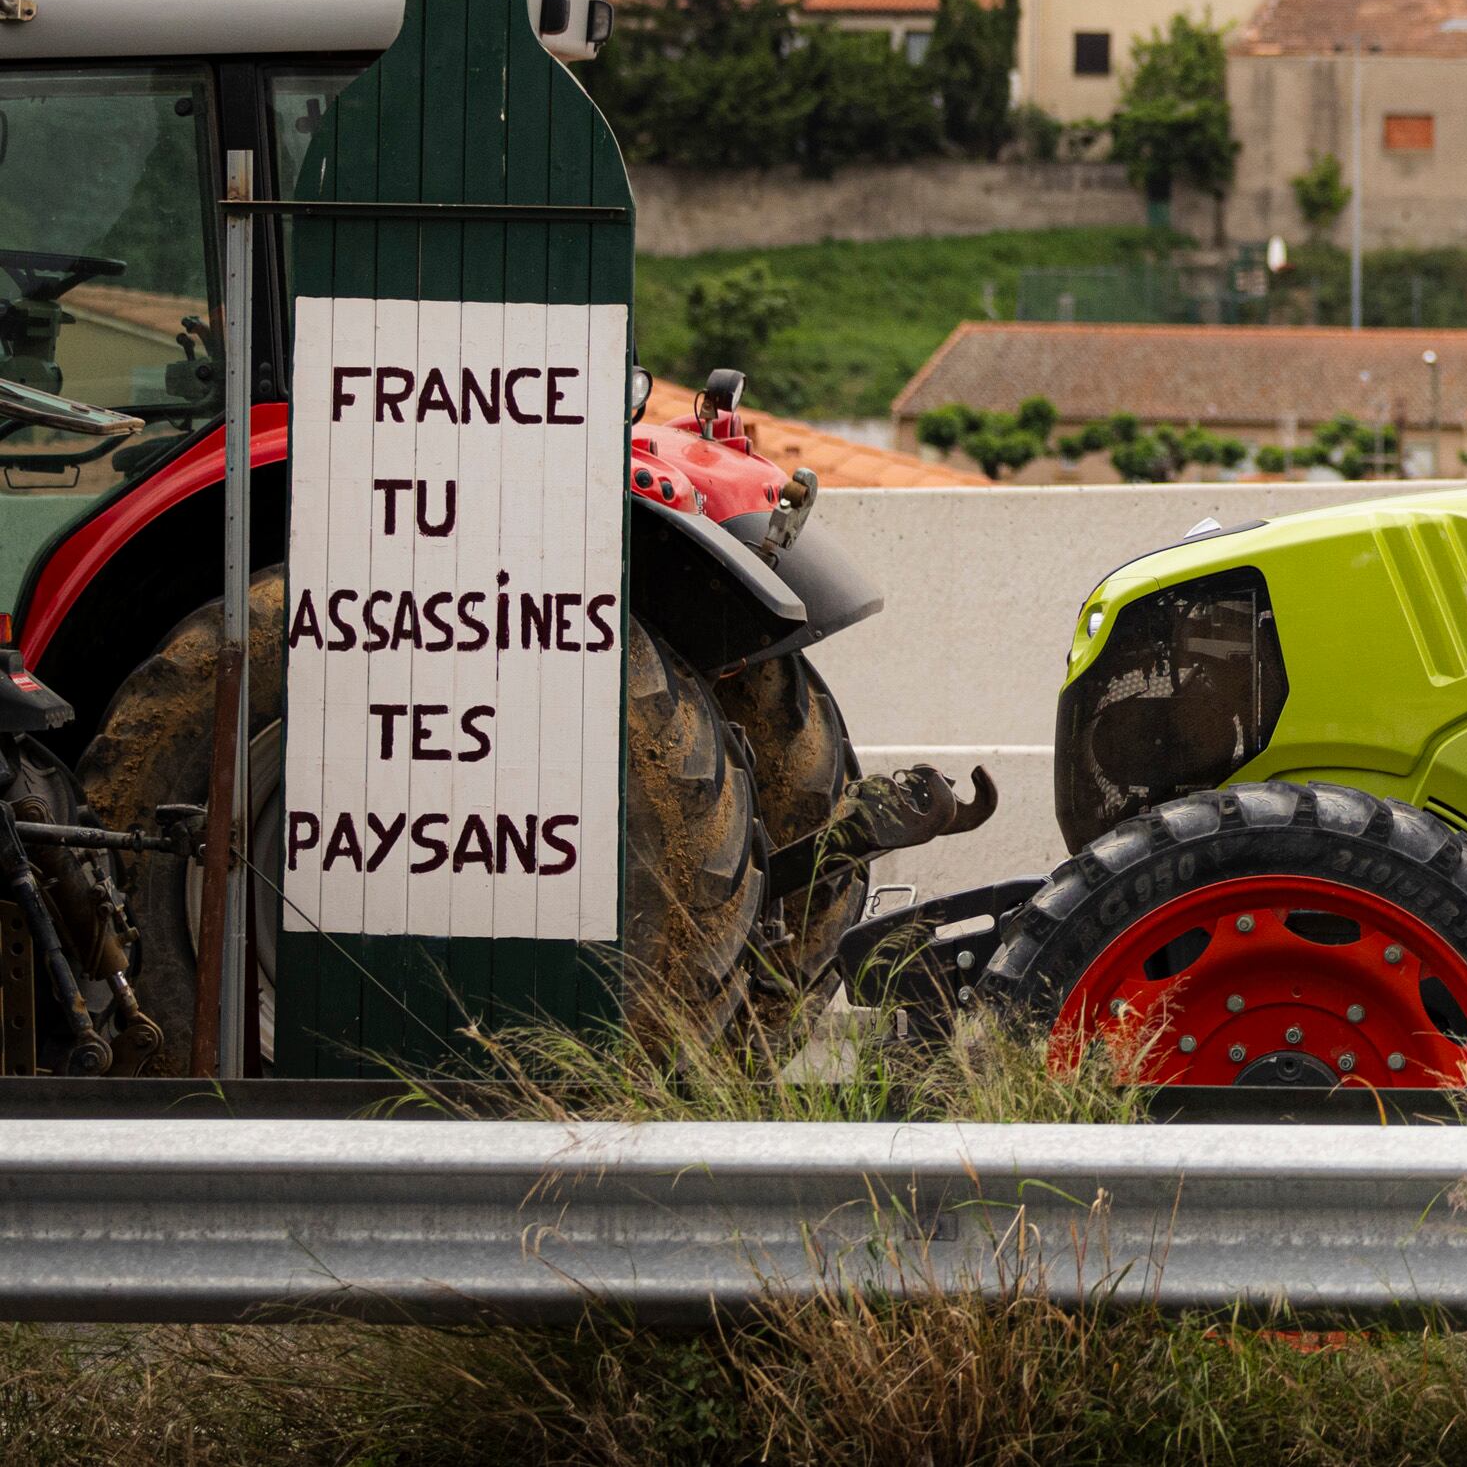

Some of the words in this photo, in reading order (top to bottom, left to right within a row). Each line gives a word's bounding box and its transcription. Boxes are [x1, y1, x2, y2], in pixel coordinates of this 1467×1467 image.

[332, 367, 584, 424] FRANCE
[374, 479, 456, 537] TU
[369, 704, 495, 762] TES
[288, 811, 579, 875] PAYSANS
